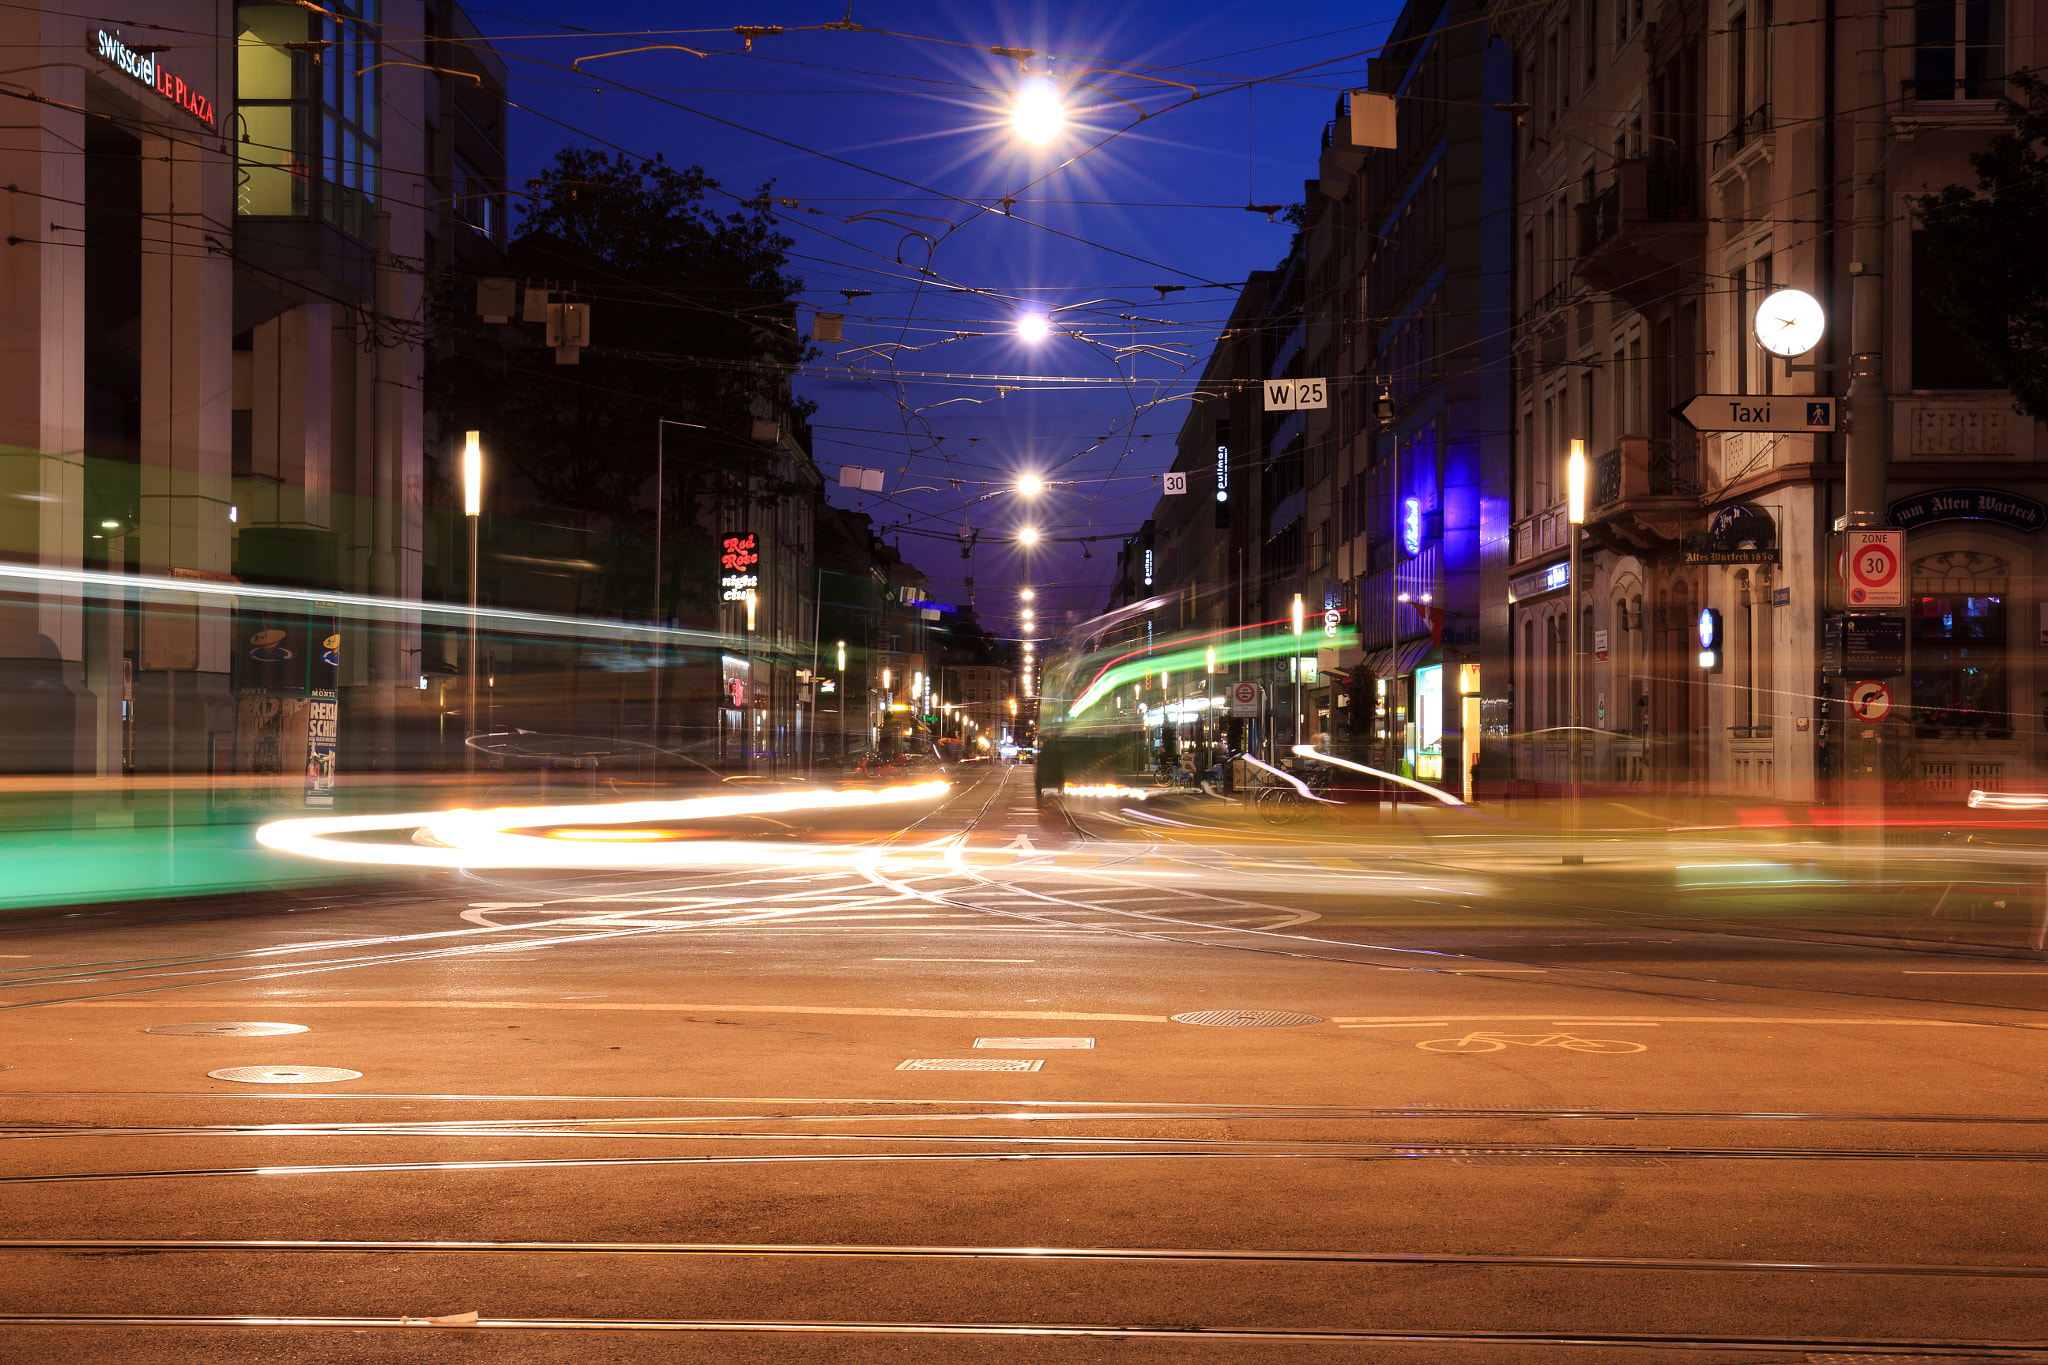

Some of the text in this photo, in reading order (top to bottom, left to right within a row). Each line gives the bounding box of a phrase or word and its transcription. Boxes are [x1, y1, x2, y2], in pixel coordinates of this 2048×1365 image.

[156, 64, 173, 99] LE
[175, 76, 214, 125] PLAZA
[1269, 384, 1323, 405] W 25
[1729, 402, 1771, 422] Taxi
[1216, 445, 1226, 489] pullman
[1166, 477, 1184, 491] 30
[1931, 496, 1969, 514] Alten
[1977, 495, 2037, 523] Warteck
[723, 534, 755, 556] Red
[1862, 534, 1888, 543] ZONE
[721, 553, 758, 572] Rose
[1685, 551, 1774, 564] Altes Warteck 1856
[1866, 558, 1884, 573] 30
[722, 575, 758, 589] night
